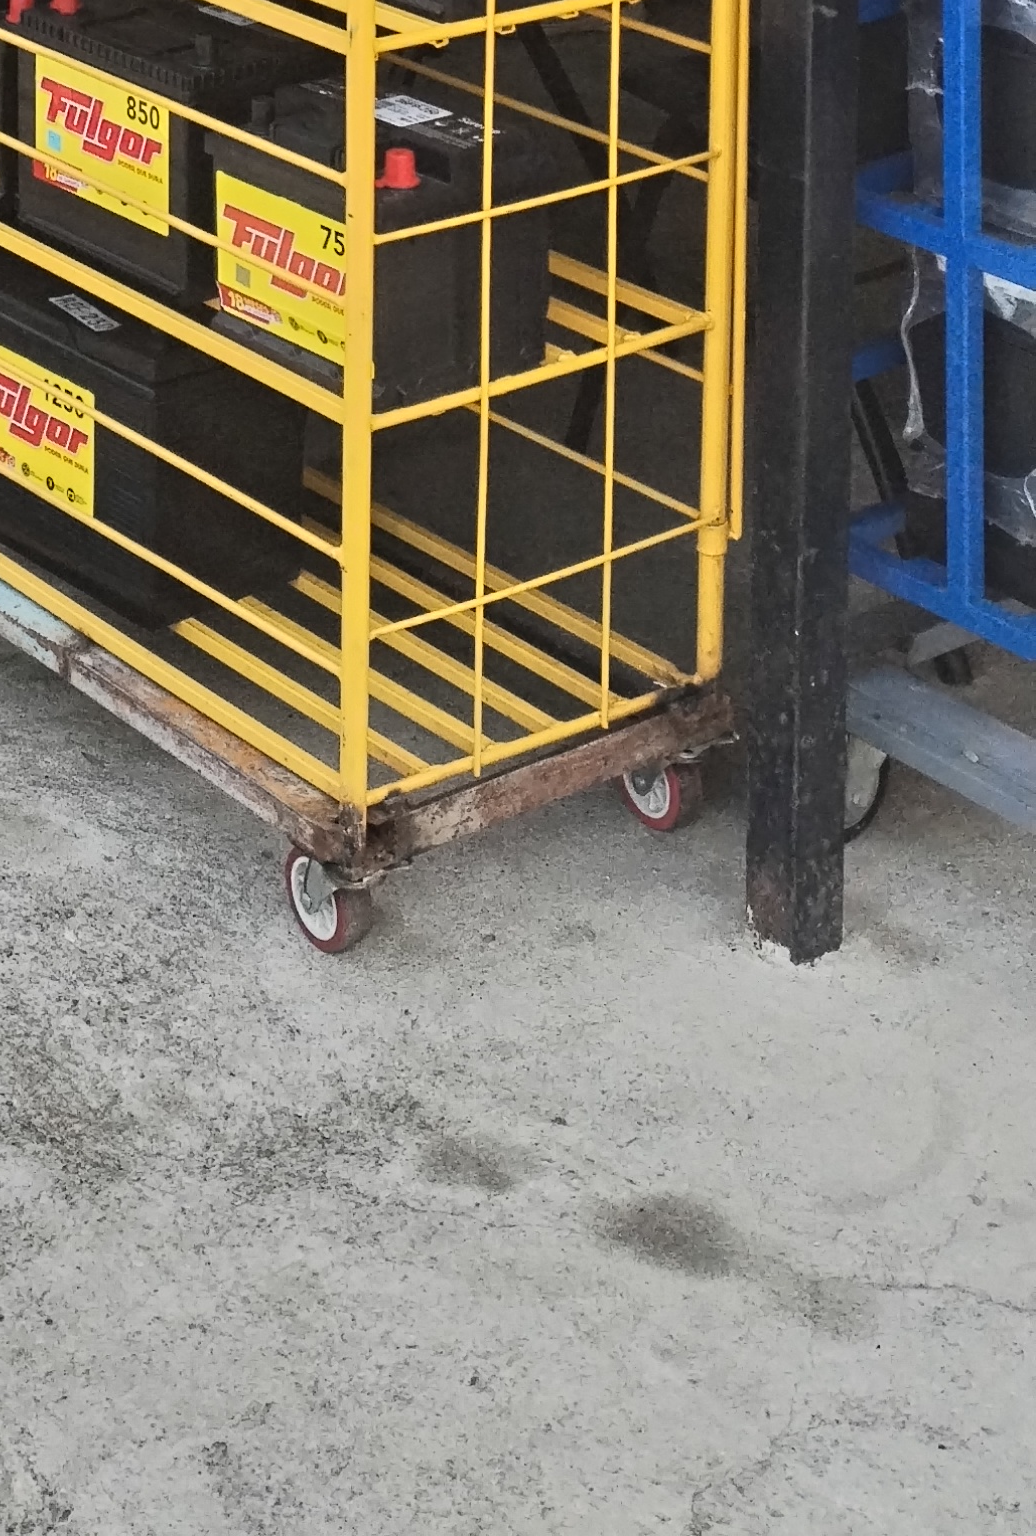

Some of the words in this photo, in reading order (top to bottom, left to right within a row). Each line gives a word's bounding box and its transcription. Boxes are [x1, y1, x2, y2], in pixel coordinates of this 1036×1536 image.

[40, 75, 163, 163] Fulgor
[126, 95, 161, 130] 850
[320, 224, 346, 257] 75
[227, 292, 245, 311] 18
